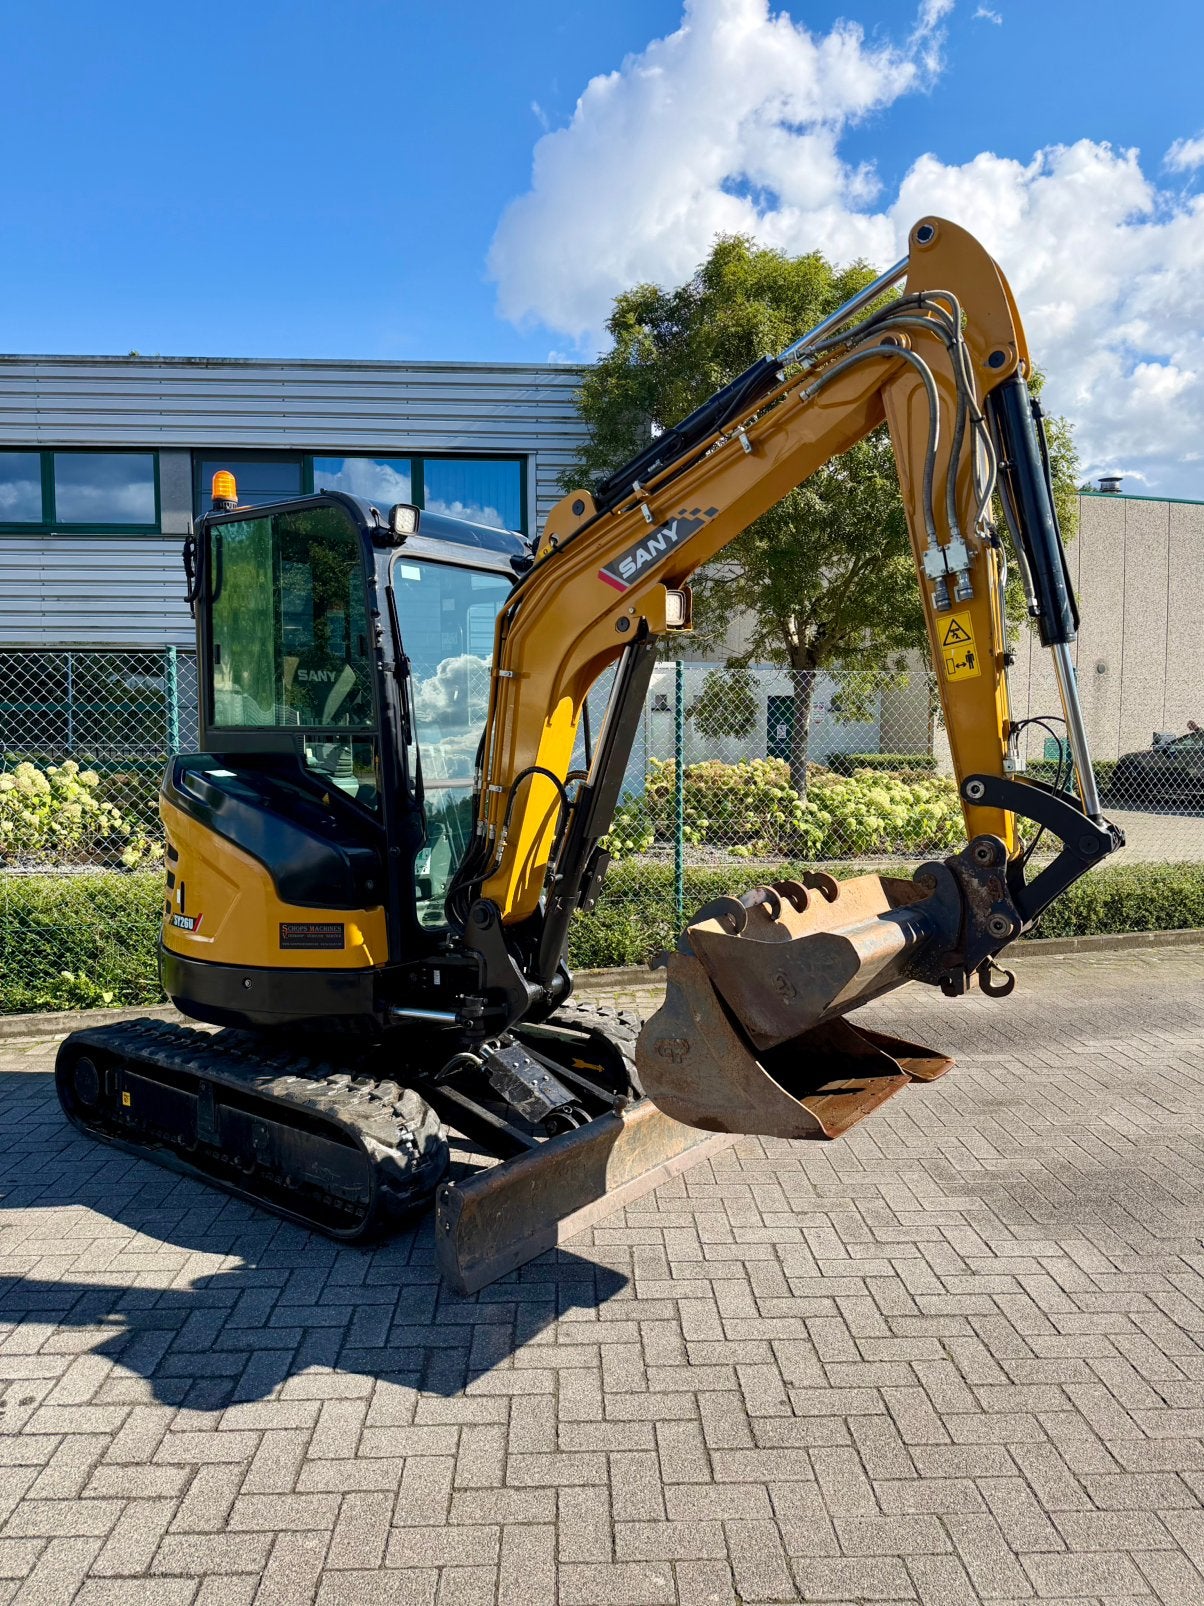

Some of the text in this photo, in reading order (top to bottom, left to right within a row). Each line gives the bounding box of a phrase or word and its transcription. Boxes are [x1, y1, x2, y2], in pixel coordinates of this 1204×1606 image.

[618, 520, 678, 579] SANY
[297, 669, 337, 682] SANY
[173, 914, 194, 930] SY26U
[282, 924, 308, 932] SCHOPS
